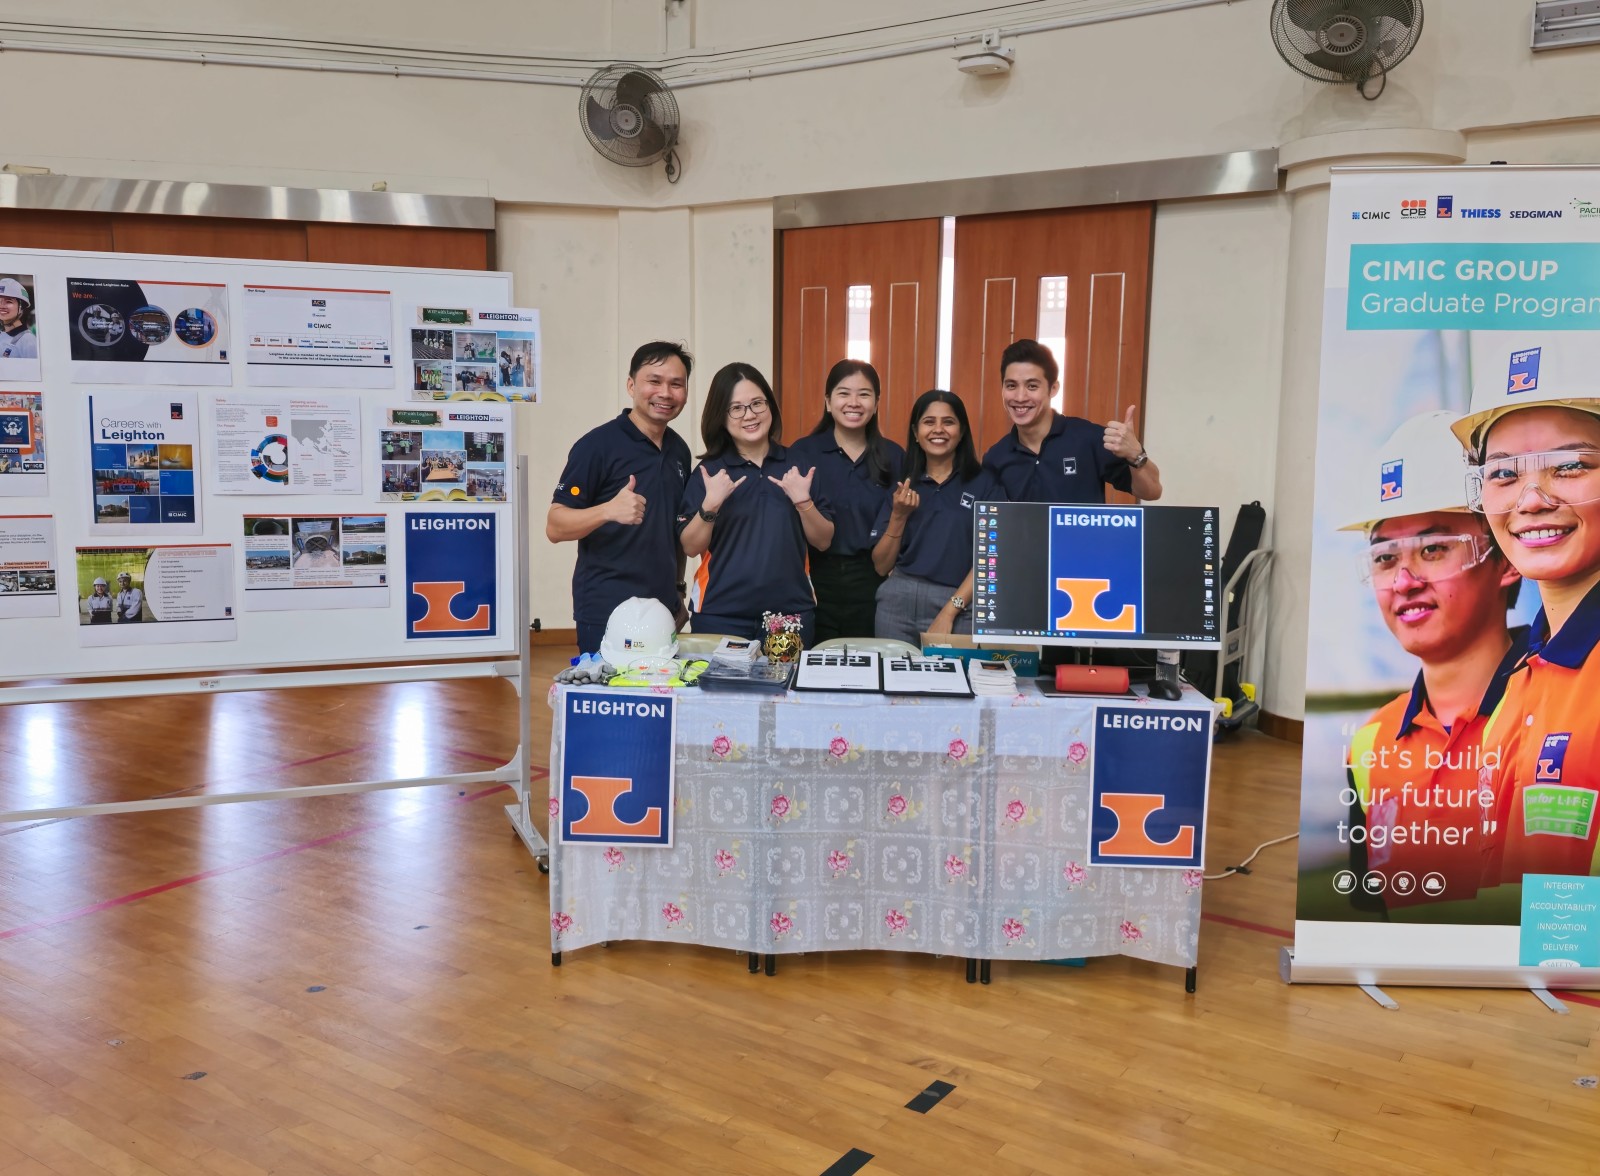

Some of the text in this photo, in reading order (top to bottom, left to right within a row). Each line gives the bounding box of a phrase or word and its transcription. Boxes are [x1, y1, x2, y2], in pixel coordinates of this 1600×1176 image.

[1361, 211, 1391, 220] CIMIC
[1400, 207, 1427, 216] CPB
[1460, 208, 1502, 219] THIESS
[1509, 210, 1563, 219] SEDGMAN
[1362, 259, 1559, 282] CIMIC GROUP
[1361, 291, 1486, 314] Graduate
[100, 418, 144, 428] Careers
[102, 428, 165, 442] Leighton
[411, 518, 490, 531] LEIGHTON
[1056, 514, 1137, 528] LEIGHTON
[572, 700, 665, 718] LEIGHTON
[1103, 714, 1202, 732] LEIGHTON
[1341, 744, 1502, 770] Let’s build
[1338, 782, 1495, 808] our future
[1336, 820, 1474, 848] together
[1543, 882, 1585, 890] INTEGRITY
[1529, 902, 1597, 912] ACCOUNTABILITY
[1536, 922, 1587, 932] INNOVATION
[1542, 943, 1580, 952] DELIVERY
